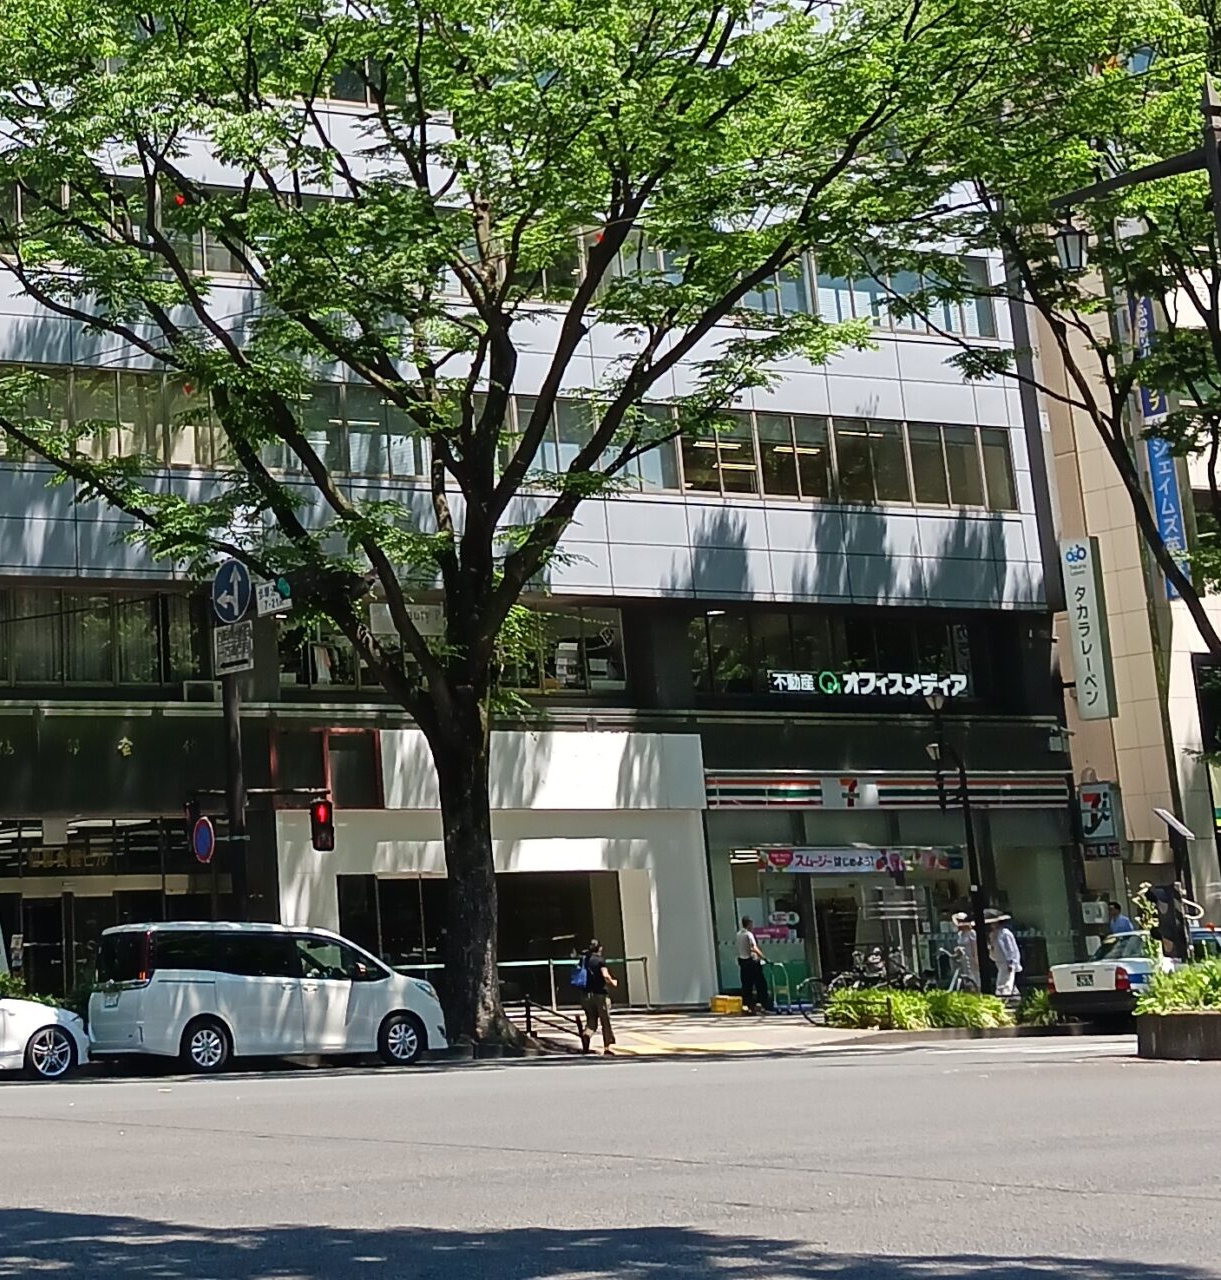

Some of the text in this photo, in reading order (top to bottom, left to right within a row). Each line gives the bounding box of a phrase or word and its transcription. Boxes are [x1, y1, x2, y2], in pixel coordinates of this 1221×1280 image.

[1074, 586, 1099, 706] タカラレーベン
[772, 673, 815, 691] 不動産
[843, 672, 968, 696] オフィスメディア
